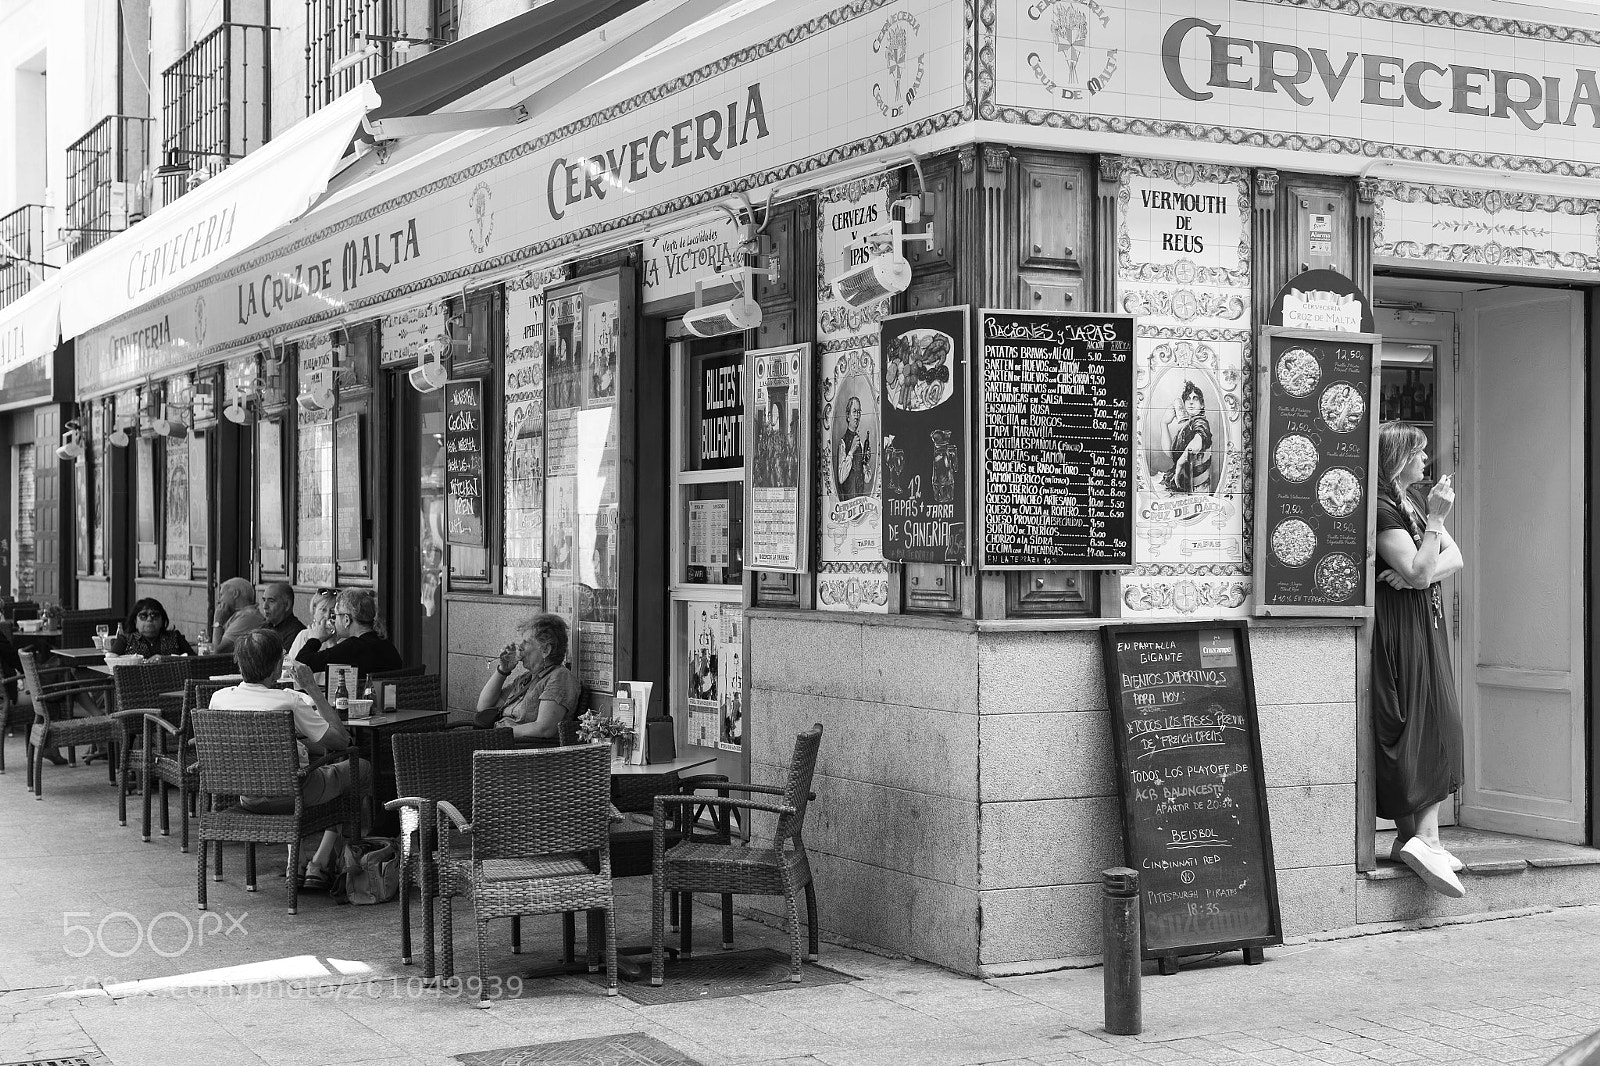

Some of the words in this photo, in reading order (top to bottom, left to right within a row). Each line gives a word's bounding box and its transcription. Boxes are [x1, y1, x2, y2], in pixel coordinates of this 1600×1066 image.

[1026, 52, 1057, 94] CRUZ
[1061, 88, 1083, 100] DE
[1087, 48, 1118, 96] MALTA
[1161, 17, 1600, 131] CERVECERIA
[873, 83, 889, 117] CRUZ
[891, 105, 904, 117] DE
[906, 52, 925, 106] MALTA
[547, 82, 770, 221] CERVECERIA
[1141, 189, 1227, 214] VERMOUTH
[832, 204, 878, 232] CERVEZAS
[1176, 215, 1193, 231] DE
[127, 202, 237, 299] CERVECERIA
[1162, 233, 1204, 254] REUS
[238, 283, 257, 325] LA
[261, 264, 303, 318] CRUZ
[308, 258, 332, 296] DE
[342, 218, 420, 292] MALTA
[642, 258, 660, 288] LA
[664, 242, 732, 279] VICTORIA
[1302, 303, 1342, 313] CERVECERIA
[1289, 310, 1312, 322] CRUZ
[1314, 314, 1324, 322] DE
[1326, 312, 1357, 325] MALTA
[984, 317, 1054, 340] RACIONES
[1066, 322, 1117, 342] TAPAS
[985, 345, 1018, 358] PATATAS
[1021, 347, 1048, 360] BRAVAS
[985, 359, 1014, 370] SARTEN
[1022, 359, 1049, 372] HUEVOS
[984, 370, 1014, 381] SARTEN
[1022, 371, 1049, 383] HUEVOS
[706, 364, 736, 410] BILLETES
[985, 382, 1012, 393] SARTEN
[1020, 383, 1047, 393] HUEVOS
[985, 393, 1029, 403] ALBONDIGAS
[1041, 393, 1063, 405] SALSA
[1030, 404, 1050, 415] RUSA
[1030, 415, 1062, 427] BURGOS
[702, 415, 736, 460] BULLFIGHT
[986, 425, 1009, 437] TAPA
[1021, 437, 1057, 450] ESPAÑOLA
[985, 448, 1030, 462] CROQUETAS
[985, 461, 1027, 473] CROQUETAS
[1037, 462, 1055, 474] RABO
[1059, 463, 1079, 475] TORO
[908, 474, 922, 500] 12
[987, 482, 1007, 493] LOMO
[986, 493, 1011, 504] QUESO
[1043, 495, 1077, 506] ARTESANO
[888, 498, 918, 518] TAPAS
[926, 503, 954, 519] JARRA
[986, 504, 1011, 515] QUESO
[1051, 505, 1079, 516] ROMERO
[1142, 508, 1171, 520] CRUZ
[1173, 505, 1190, 518] DE
[1194, 502, 1227, 516] MALTA
[986, 513, 1012, 524] QUESO
[888, 523, 899, 542] DE
[986, 523, 1018, 534] SURTIDO
[858, 539, 875, 547] TAPAS
[986, 533, 1016, 544] CHORIZO
[1029, 535, 1053, 545] SIDRA
[986, 543, 1012, 553] CECINA
[1023, 544, 1064, 556] ALMENDRAS
[1117, 642, 1131, 652] EN
[1134, 640, 1176, 651] PANTALLA
[1140, 652, 1183, 664] GIGANTE
[1122, 673, 1163, 688] EVENTOS
[1133, 692, 1156, 706] PARA
[1183, 714, 1213, 727] FASES
[1141, 738, 1156, 750] DE
[1131, 769, 1159, 784] TODOS
[1164, 766, 1183, 778] LOS
[1187, 764, 1230, 777] PLAYOFF
[1235, 763, 1249, 773] DE
[1135, 788, 1158, 802] ACB
[1163, 784, 1224, 799] BALONCESTO
[1194, 801, 1203, 810] DE
[1171, 828, 1218, 842] BEISBOL
[1203, 855, 1221, 865] RED
[1148, 889, 1199, 905] PITTSBURGH
[1205, 888, 1237, 899] PIRATES
[1187, 902, 1220, 917] 18:35
